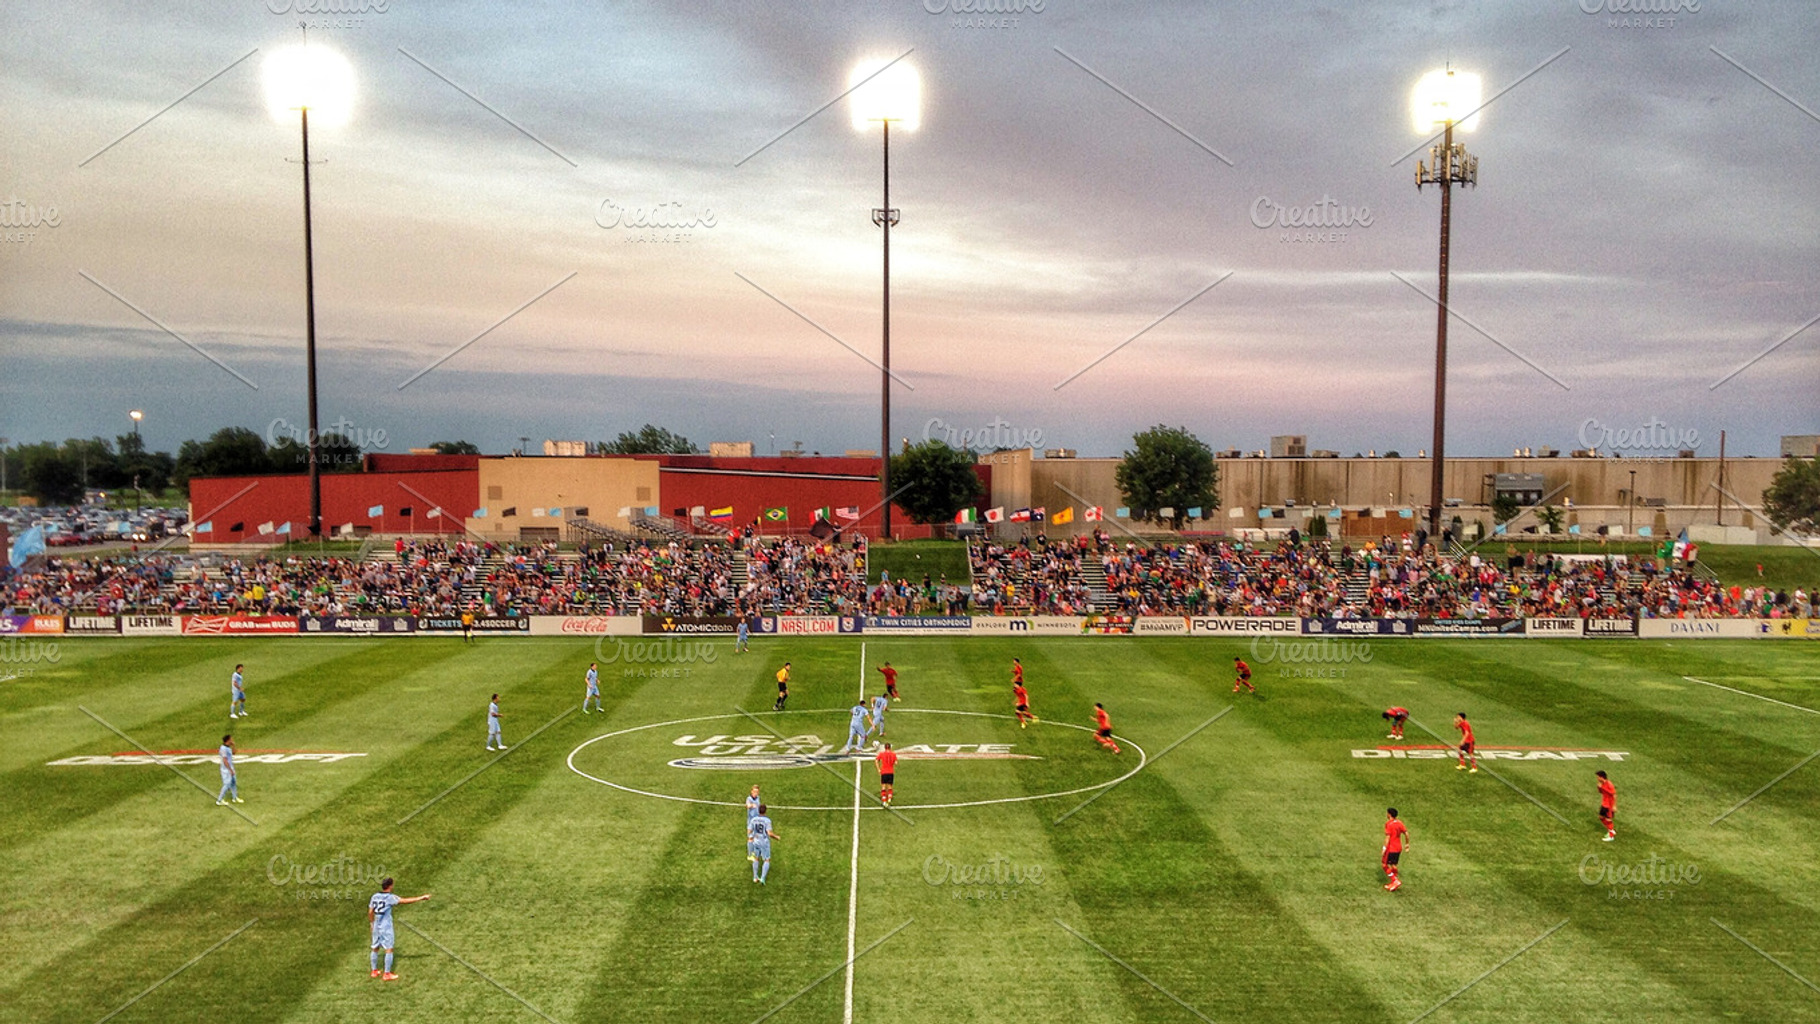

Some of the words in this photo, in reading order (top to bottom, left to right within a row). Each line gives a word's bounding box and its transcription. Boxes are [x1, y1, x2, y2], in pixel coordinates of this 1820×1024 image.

[69, 616, 116, 629] LIFETIME
[129, 617, 173, 628] LIFETIME
[229, 621, 255, 629] GRAB
[271, 621, 297, 629] BUDS
[335, 618, 376, 628] Admiral
[430, 619, 462, 628] TICKETS
[781, 620, 835, 632] NASL.COM
[881, 618, 899, 627] TWIN
[900, 618, 922, 627] CITIES
[923, 618, 970, 627] ORTHOPEDICS
[1192, 619, 1297, 631] POWERADE
[1336, 620, 1375, 630] Admiral
[1532, 619, 1576, 630] LIFETIME
[1588, 618, 1634, 631] LIFETIME
[1670, 622, 1720, 633] DASANI
[672, 734, 823, 747] USA
[1350, 749, 1630, 762] DISCRAFT
[372, 900, 386, 915] 22
